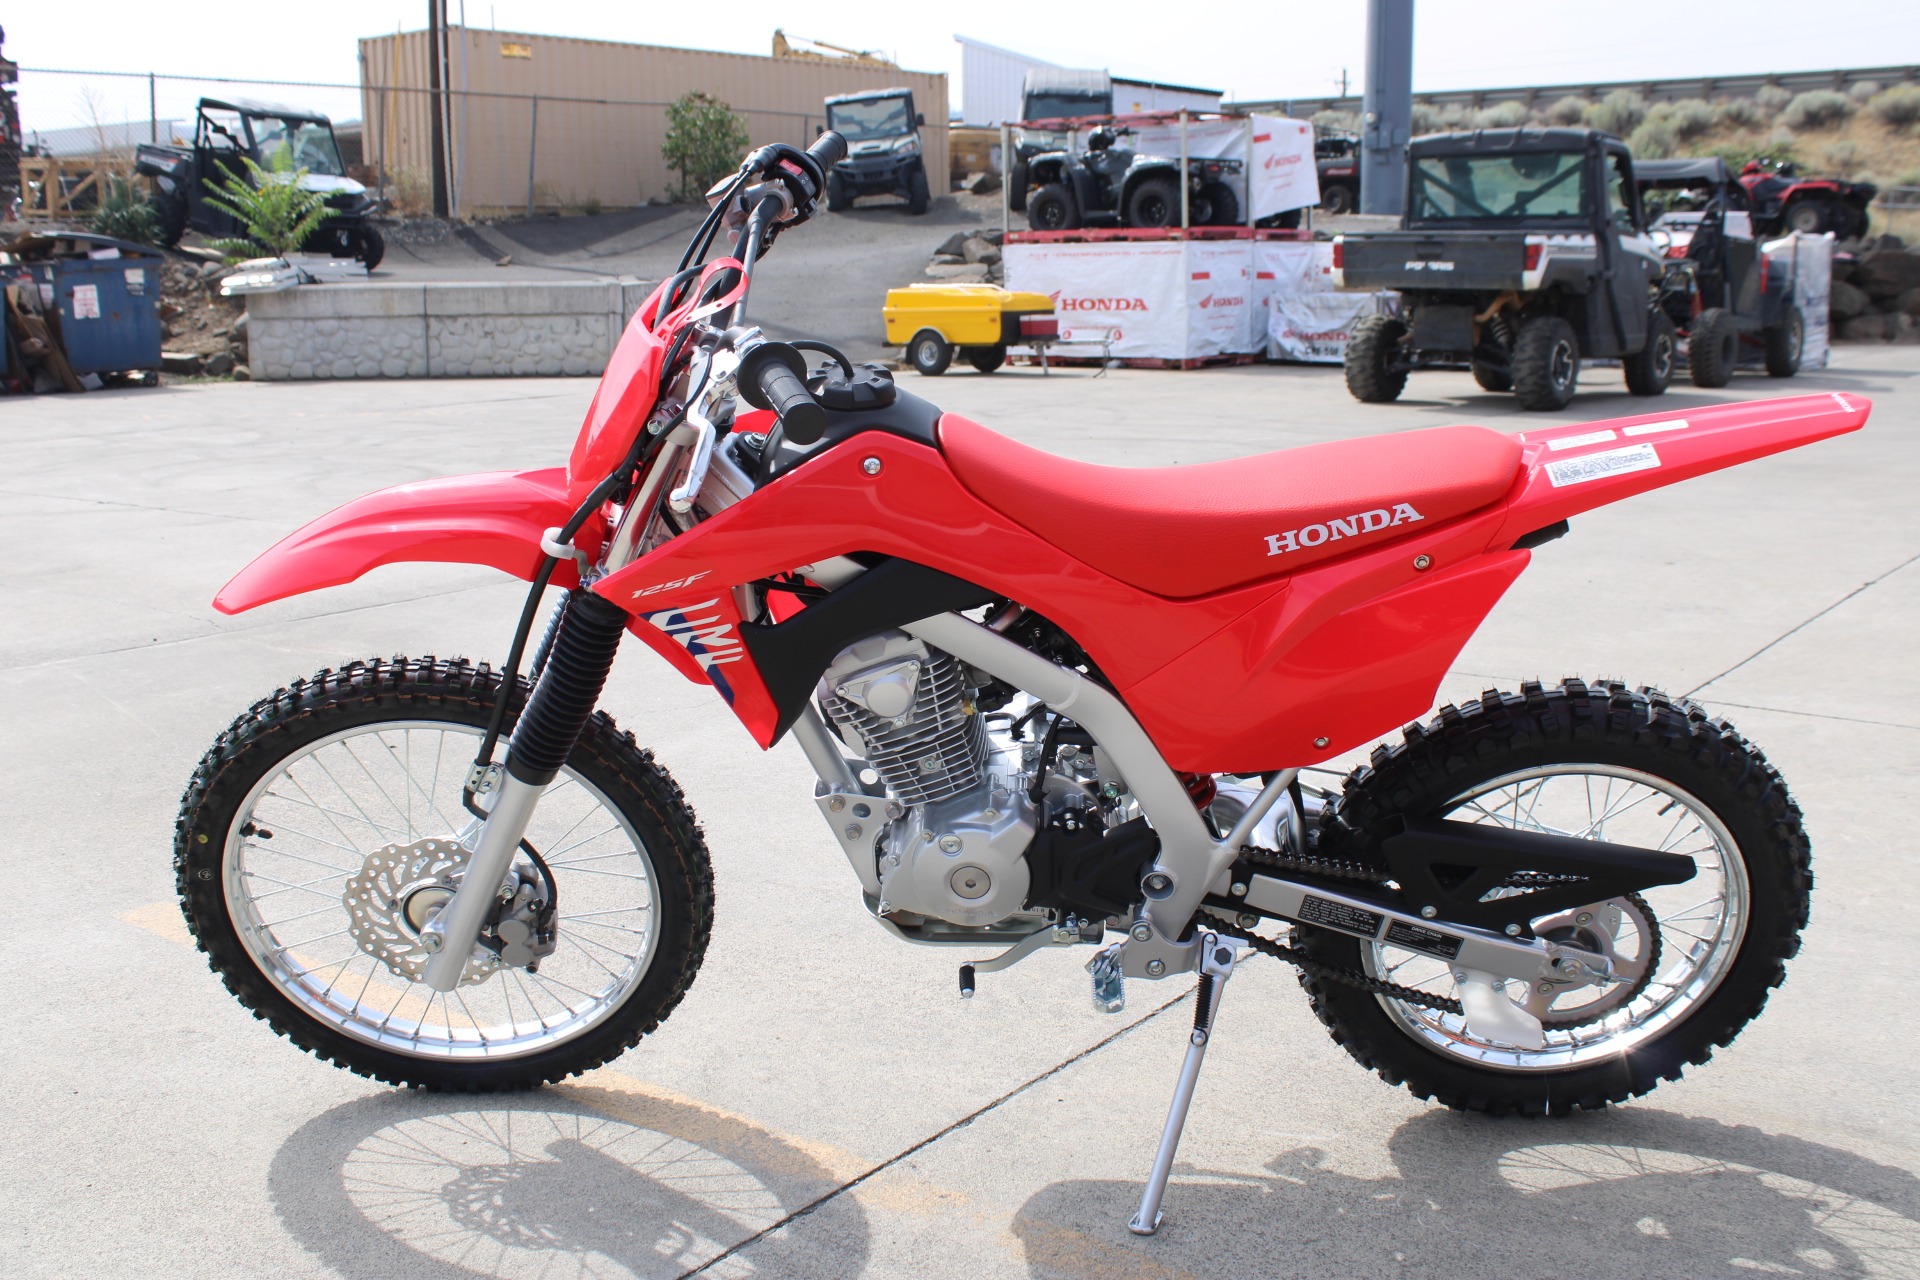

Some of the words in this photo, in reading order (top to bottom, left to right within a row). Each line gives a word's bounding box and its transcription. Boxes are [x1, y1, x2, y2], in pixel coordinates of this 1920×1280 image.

[1061, 298, 1148, 311] HONDA
[1264, 502, 1424, 556] HONDA
[631, 569, 712, 599] 125F
[1411, 926, 1427, 935] DRIVE
[1426, 930, 1443, 939] CHAIN
